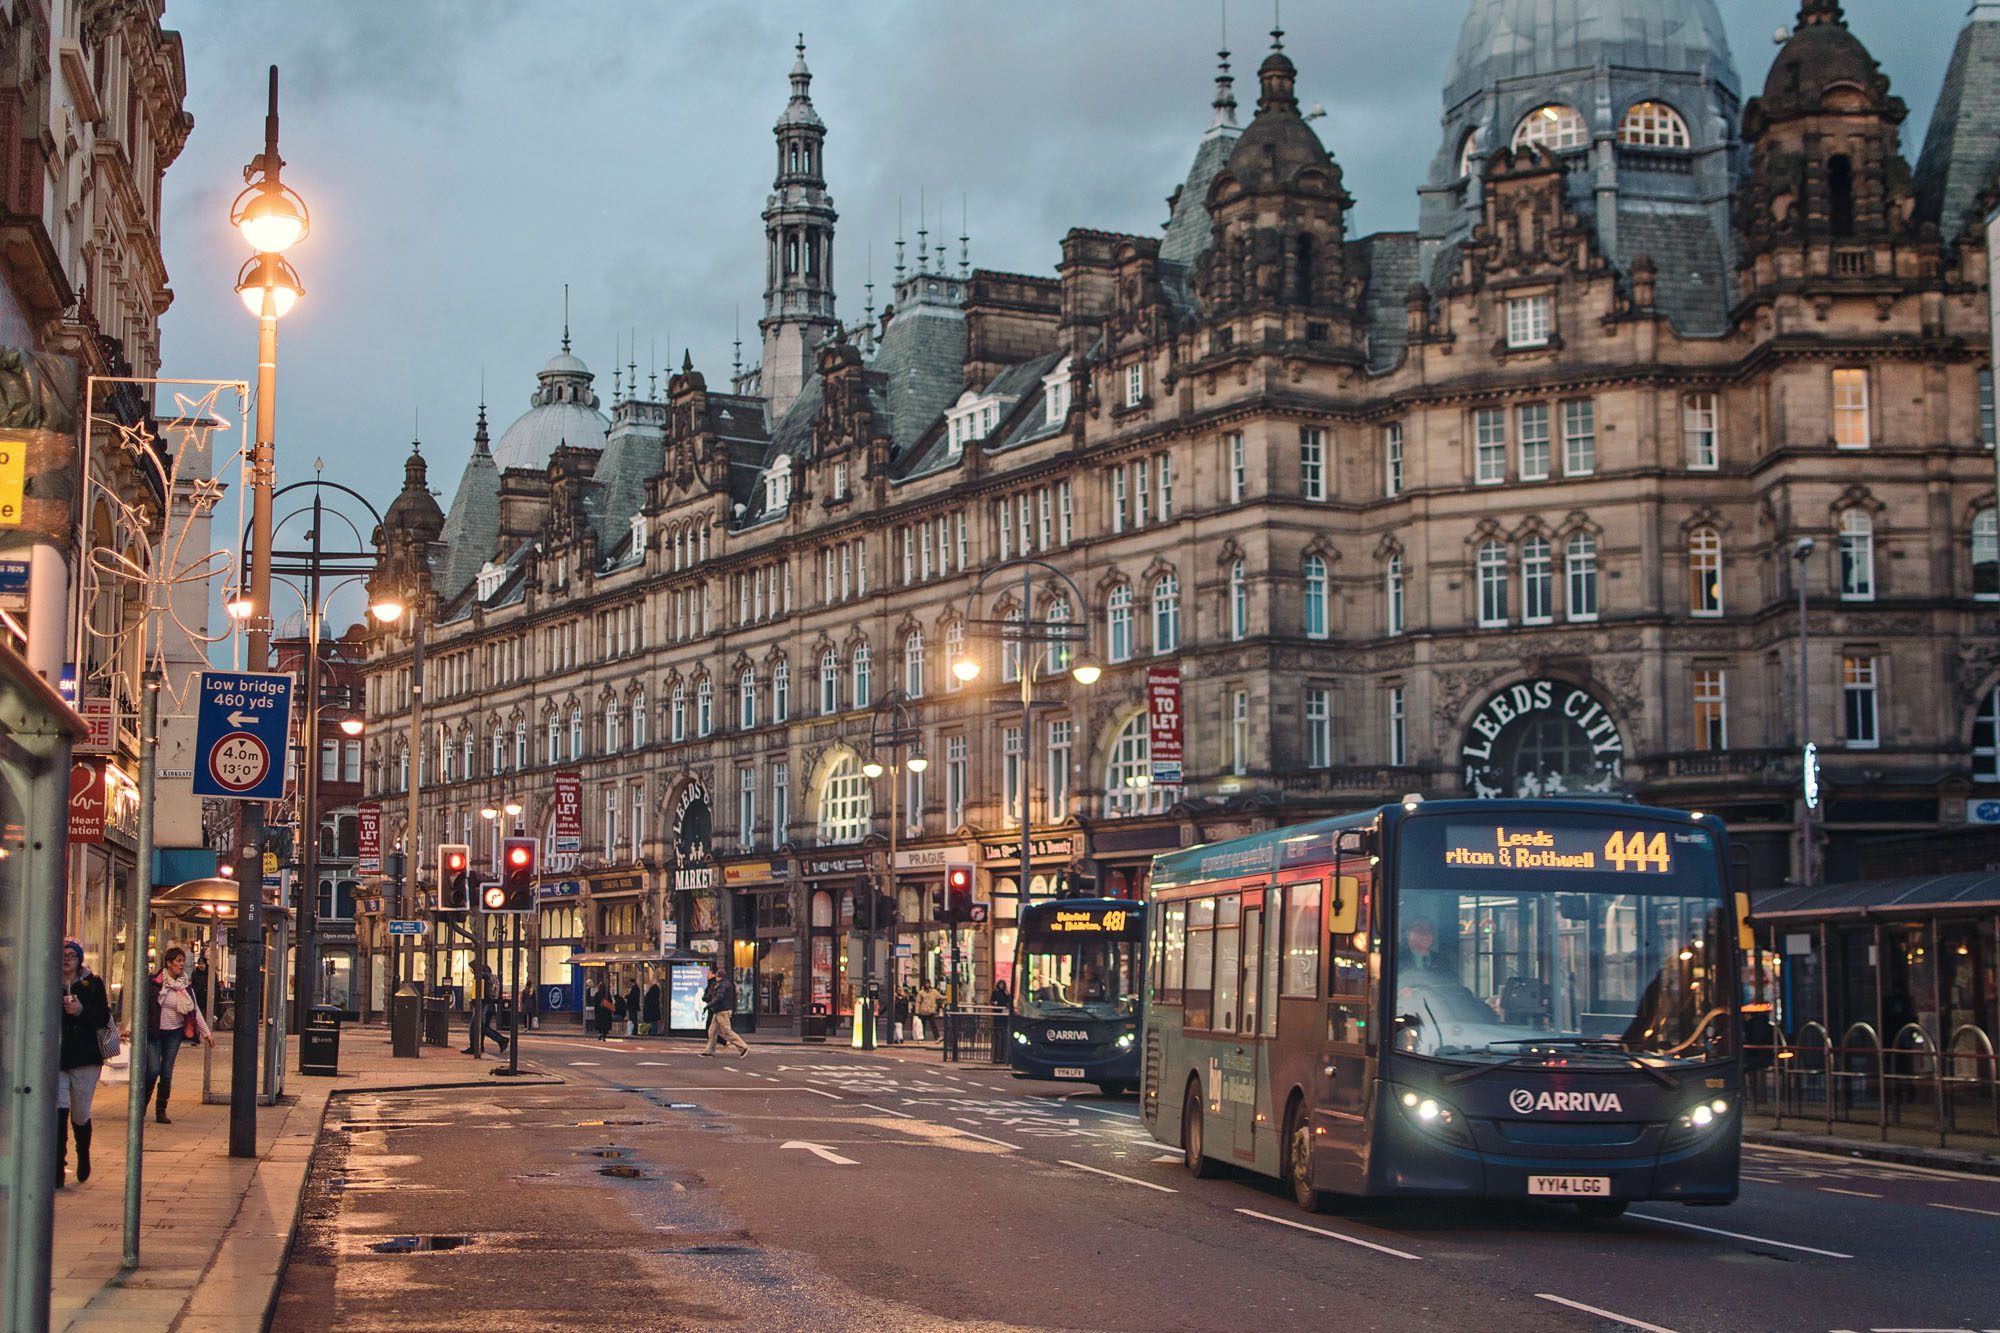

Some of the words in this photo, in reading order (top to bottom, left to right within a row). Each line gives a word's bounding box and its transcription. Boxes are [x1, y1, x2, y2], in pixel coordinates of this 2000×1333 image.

[206, 677, 235, 691] Low
[239, 679, 286, 696] bridge
[1148, 675, 1180, 684] Attractive
[1153, 686, 1175, 695] Offices
[213, 693, 245, 707] 460
[249, 695, 274, 710] yds
[1155, 697, 1174, 713] TO
[1152, 714, 1178, 730] LET
[1462, 681, 1552, 760] LEEDS
[1563, 690, 1622, 755] CITY
[223, 746, 259, 761] 4.0m
[561, 792, 575, 803] TO
[557, 803, 577, 815] LET
[672, 782, 702, 834] LEEDS
[71, 816, 100, 825] Heart
[362, 821, 376, 830] TO
[360, 830, 378, 840] LET
[1496, 827, 1554, 848] Leeds
[908, 852, 946, 865] PRAGUE
[1499, 847, 1512, 867] &
[1515, 847, 1594, 869] Rothwell
[1604, 830, 1671, 873] 444
[675, 868, 713, 891] MARKET
[1102, 910, 1127, 932] 481
[1055, 1030, 1089, 1041] ARRIVA
[1535, 1091, 1624, 1113] ARRIVA
[1537, 1177, 1568, 1192] YY14
[1572, 1178, 1601, 1193] LGG
